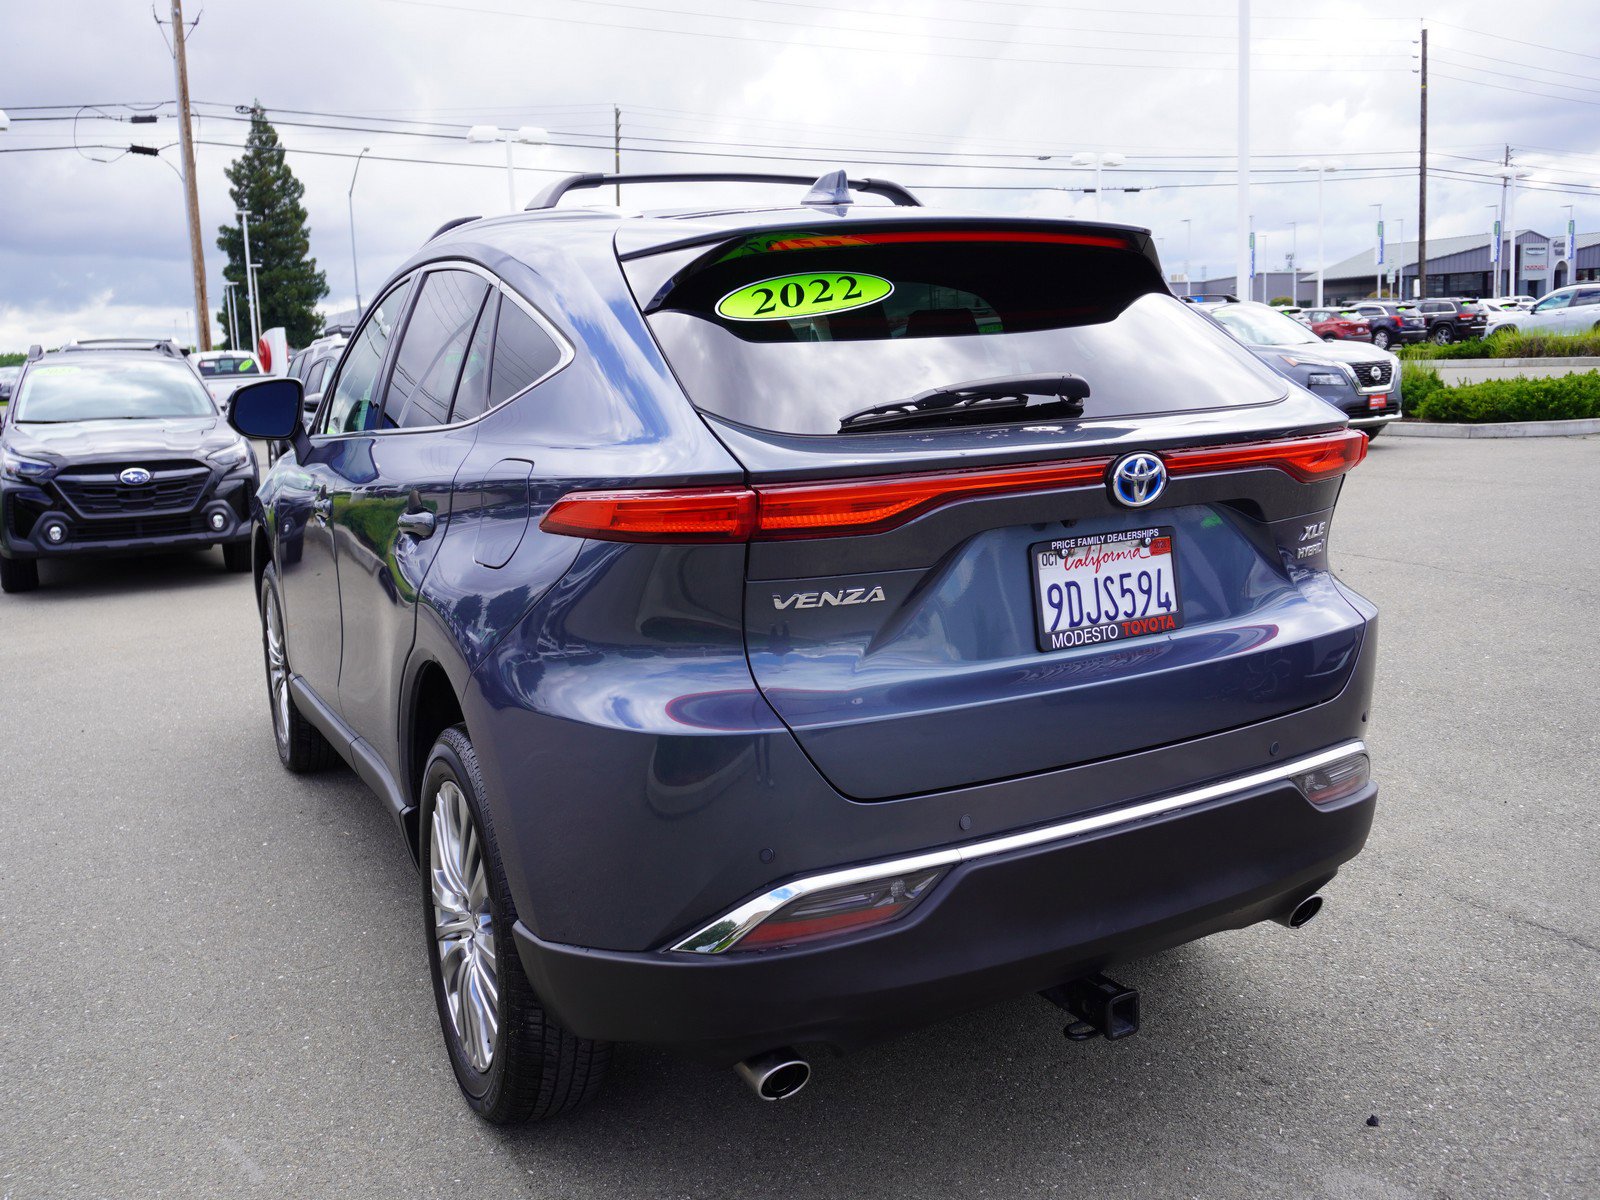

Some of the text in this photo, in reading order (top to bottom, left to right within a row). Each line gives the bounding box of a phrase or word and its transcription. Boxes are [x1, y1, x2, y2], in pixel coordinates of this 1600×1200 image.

[751, 275, 862, 315] 2022
[1051, 528, 1159, 550] PRICE FAMILY DEALERSHIPS
[1298, 521, 1326, 541] XLE
[1041, 552, 1058, 567] OCT
[1063, 546, 1151, 574] California
[772, 586, 886, 610] VENZA
[1047, 568, 1172, 632] 9DJS594
[1052, 615, 1176, 649] MODESTO TOYOTA
